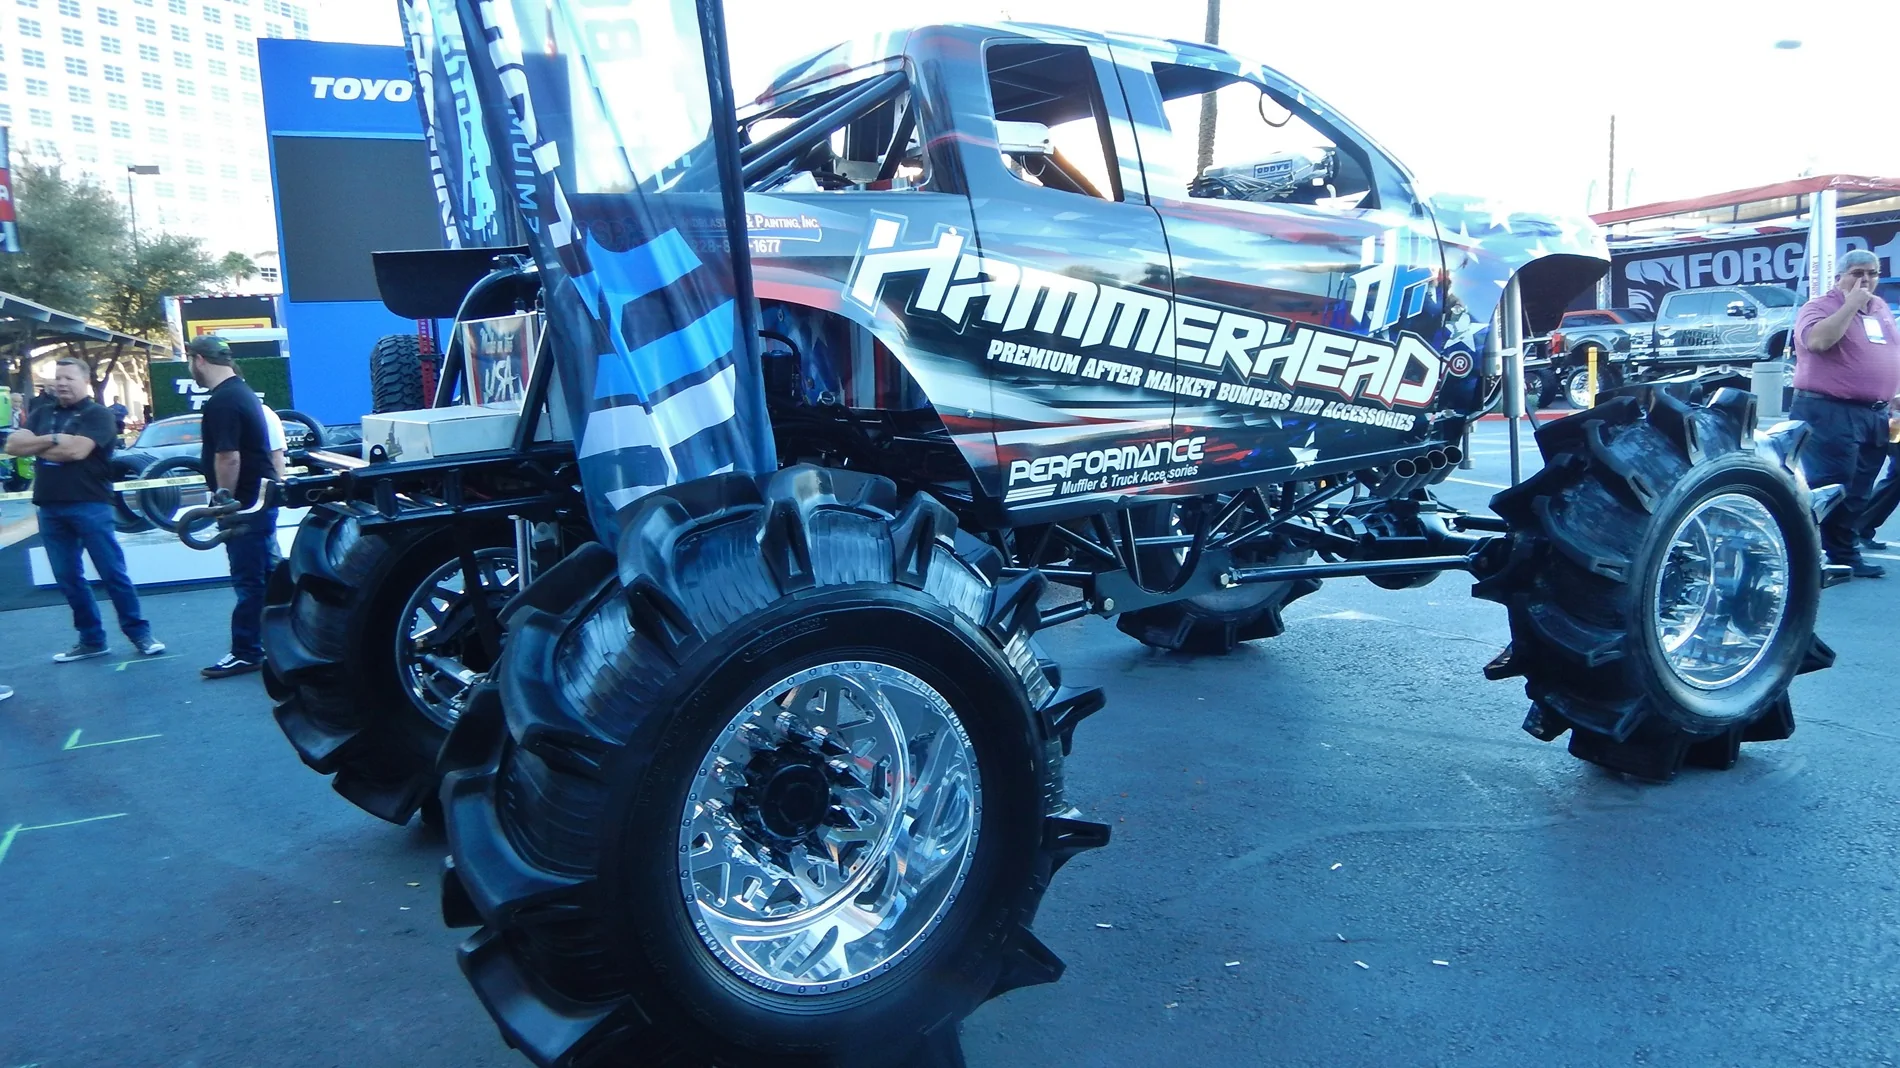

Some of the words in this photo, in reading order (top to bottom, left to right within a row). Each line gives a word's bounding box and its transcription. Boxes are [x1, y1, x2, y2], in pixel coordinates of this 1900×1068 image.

[310, 76, 413, 102] TOYO
[1257, 163, 1290, 174] ODDY'S
[848, 215, 1442, 406] HAMMERHEAD
[987, 340, 1082, 375] PREMIUM
[1081, 358, 1144, 386] AFTER
[1144, 369, 1218, 399] MARKET
[1216, 383, 1292, 411] BUMPERS
[1290, 396, 1325, 415] AND
[1322, 404, 1416, 432] ACCESSORIES
[1009, 437, 1207, 487] PERFORMANCE
[1060, 479, 1099, 495] Muffler
[1100, 476, 1108, 489] &
[1111, 471, 1140, 488] Truck
